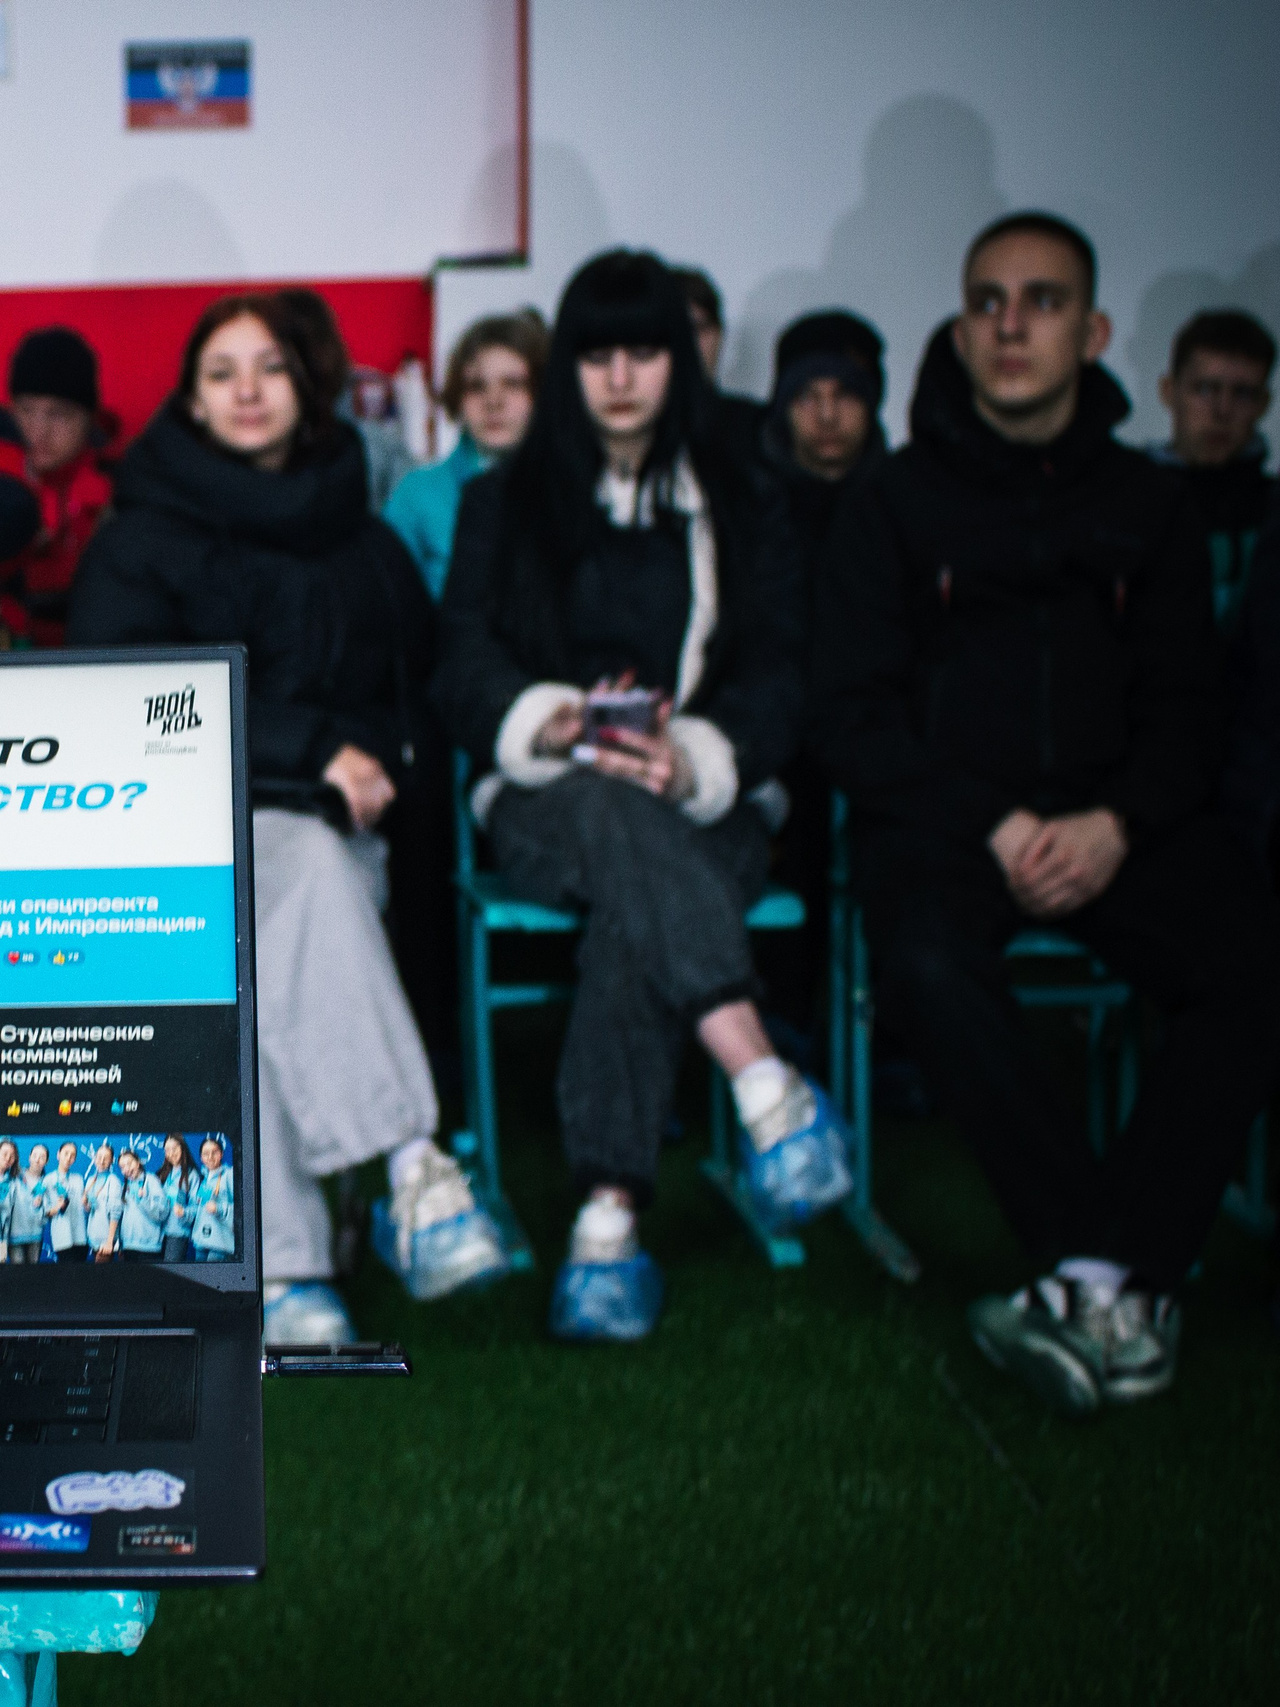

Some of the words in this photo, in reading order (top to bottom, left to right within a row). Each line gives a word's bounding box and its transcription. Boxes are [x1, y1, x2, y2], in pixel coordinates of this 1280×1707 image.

[21, 895, 158, 915] спецпроекта
[36, 915, 206, 937] Импровизация»
[1, 1025, 154, 1045] Студенческие
[1, 1048, 97, 1065] команды
[1, 1066, 121, 1086] колледжей
